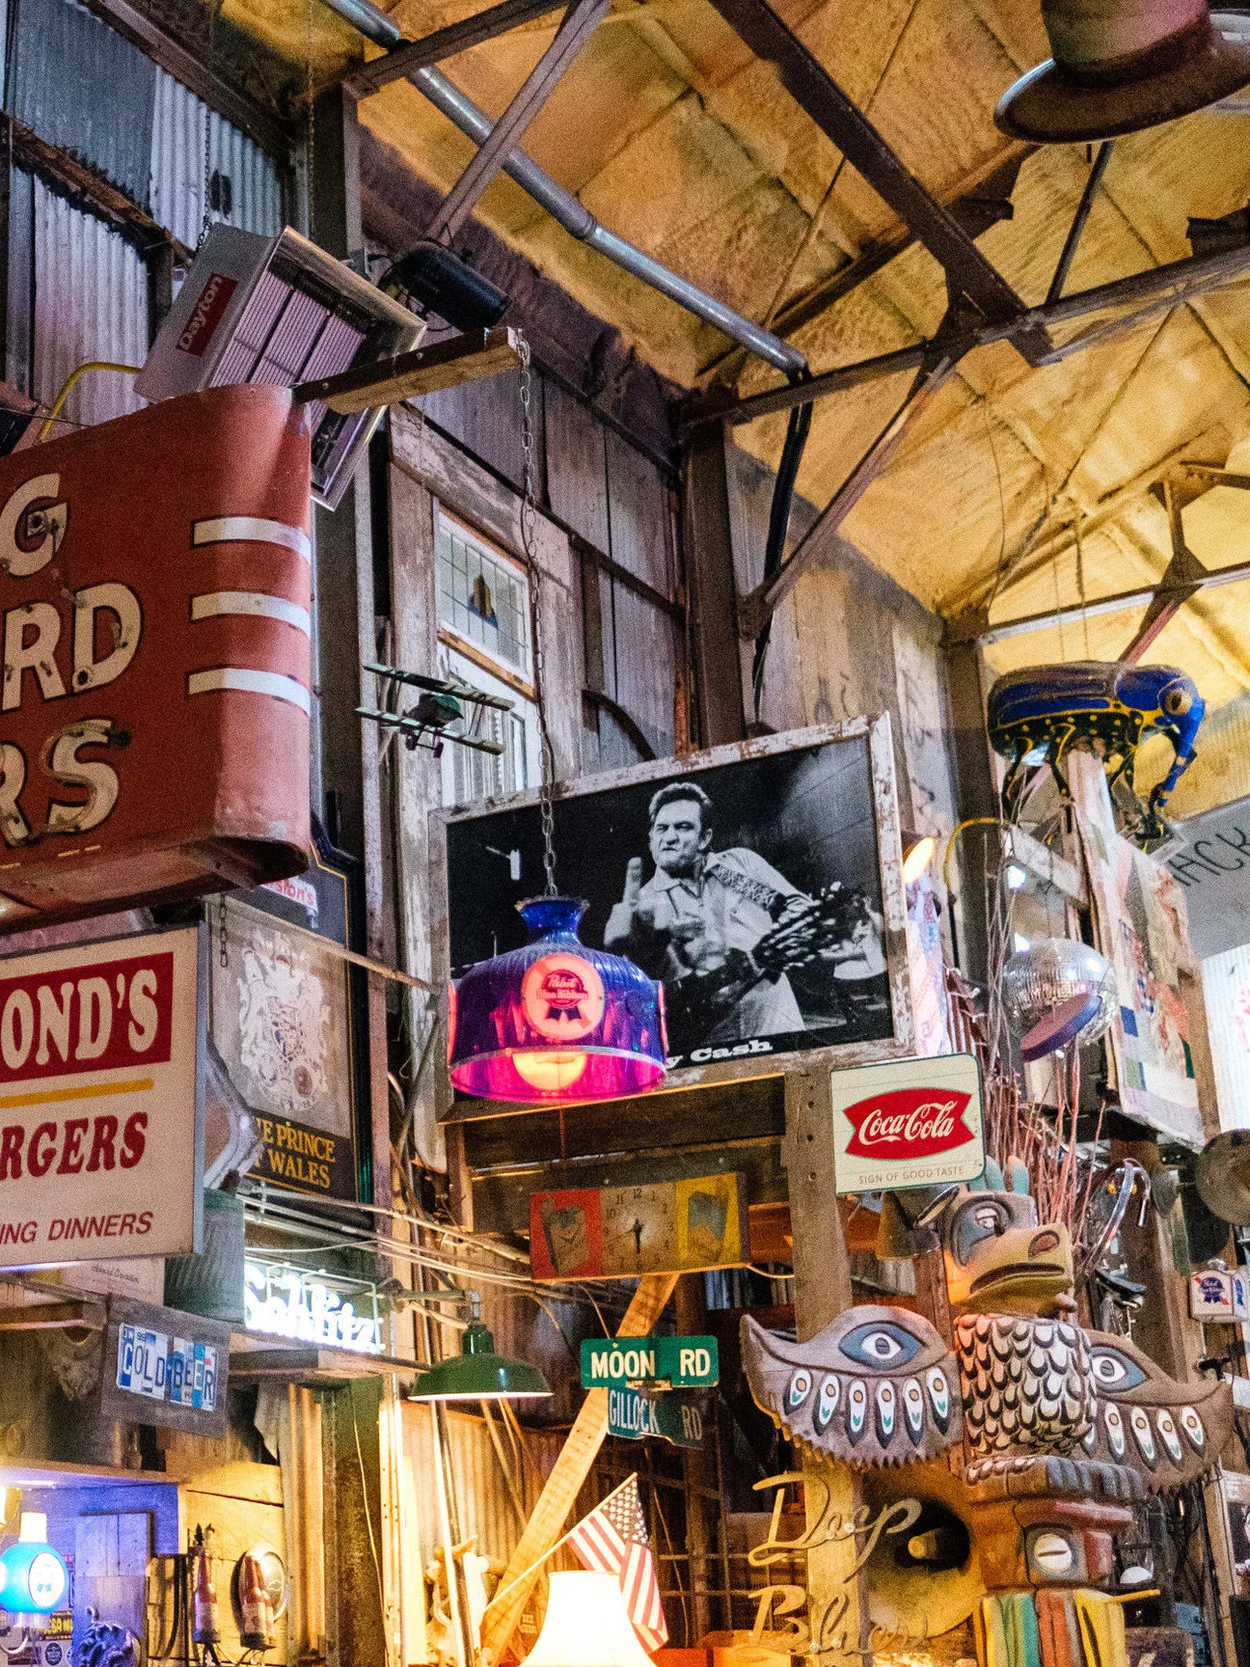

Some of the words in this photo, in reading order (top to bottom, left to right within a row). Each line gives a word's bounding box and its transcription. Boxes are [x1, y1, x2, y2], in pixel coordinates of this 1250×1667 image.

[178, 276, 222, 350] Dayton
[547, 973, 578, 988] Pabst
[690, 1039, 773, 1063] Cash
[276, 1123, 336, 1163] PRINCE
[858, 1100, 958, 1146] Coca-Cola
[267, 1148, 330, 1189] WALES
[858, 1173, 883, 1185] SIGN
[885, 1172, 899, 1182] OF
[902, 1168, 934, 1180] GOOD
[936, 1166, 964, 1177] TASTE
[47, 1210, 155, 1242] DINNERS
[122, 1342, 166, 1388] COLD
[172, 1357, 214, 1406] BEER
[591, 1350, 655, 1379] MOON
[679, 1348, 711, 1377] RD
[609, 1388, 661, 1435] GILLOCK
[680, 1403, 703, 1441] RD
[748, 1470, 923, 1584] Deep
